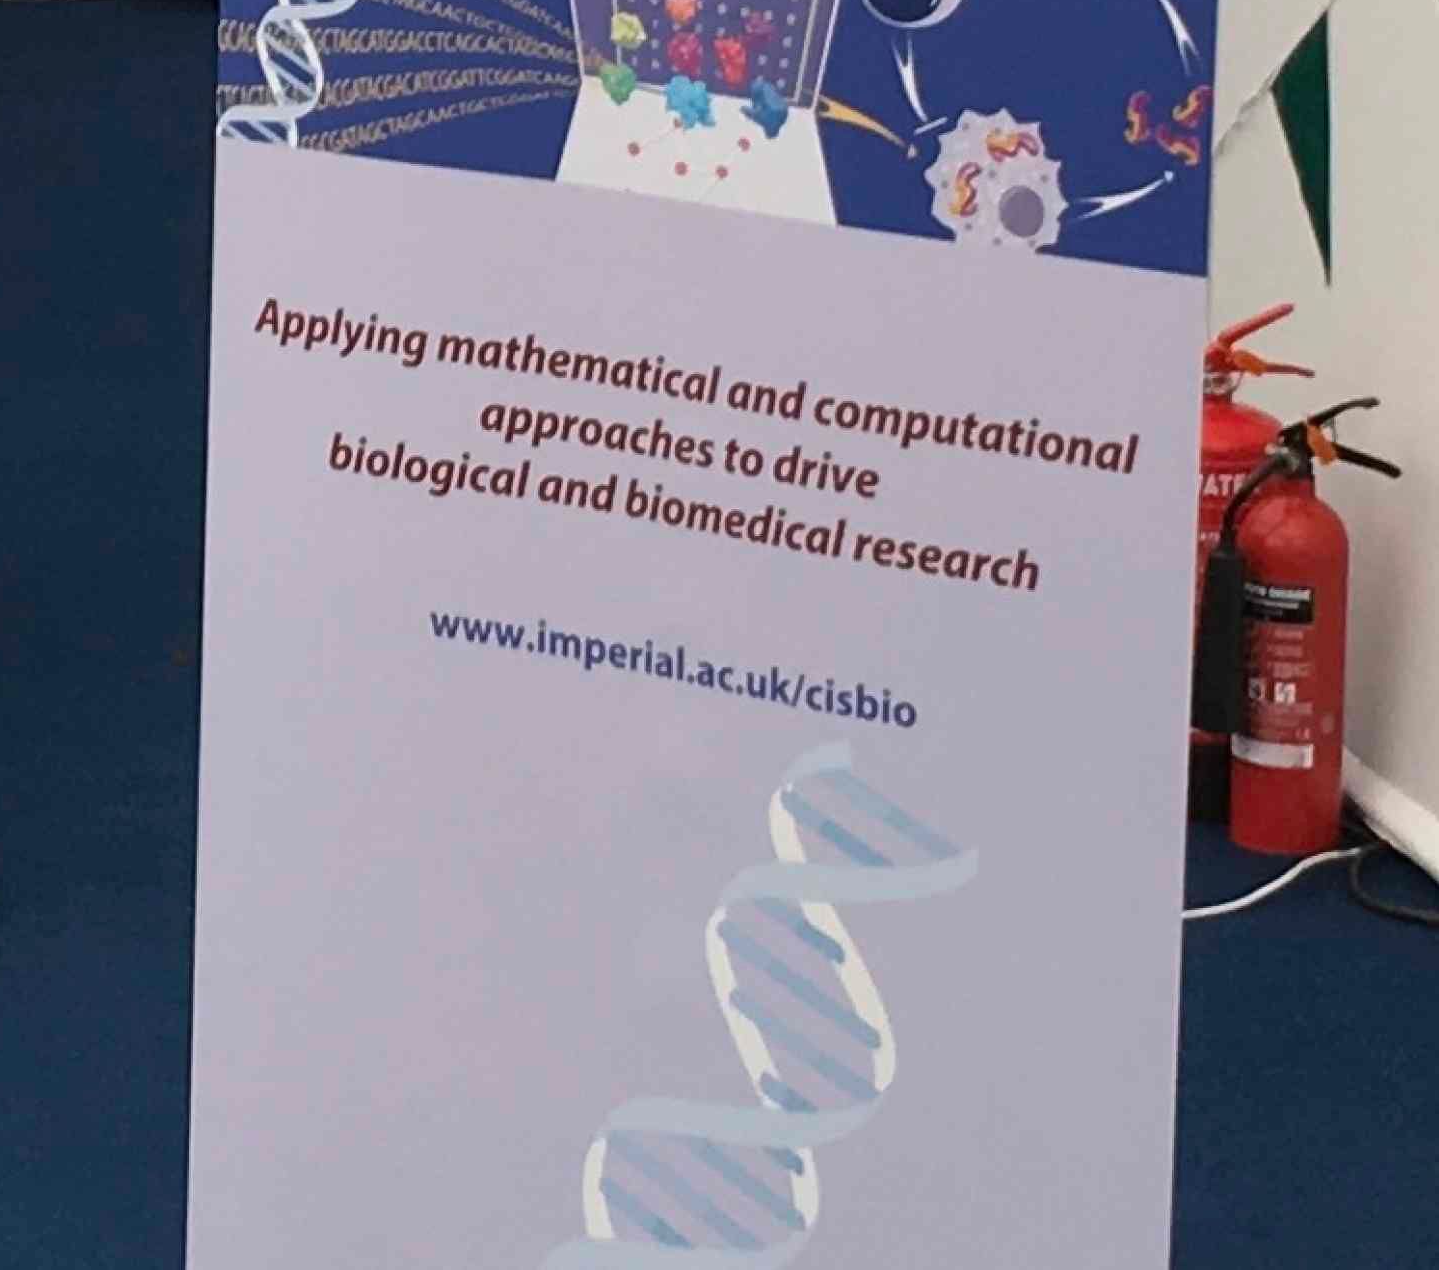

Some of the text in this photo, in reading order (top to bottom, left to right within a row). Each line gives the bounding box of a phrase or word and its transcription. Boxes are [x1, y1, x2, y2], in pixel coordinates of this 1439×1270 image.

[254, 298, 1140, 475] Applying mathematical and computational
[479, 404, 880, 500] approaches to drive
[329, 431, 1040, 591] biological and biomedical research
[429, 611, 918, 729] www.imperial.ac.uk/cisbio
